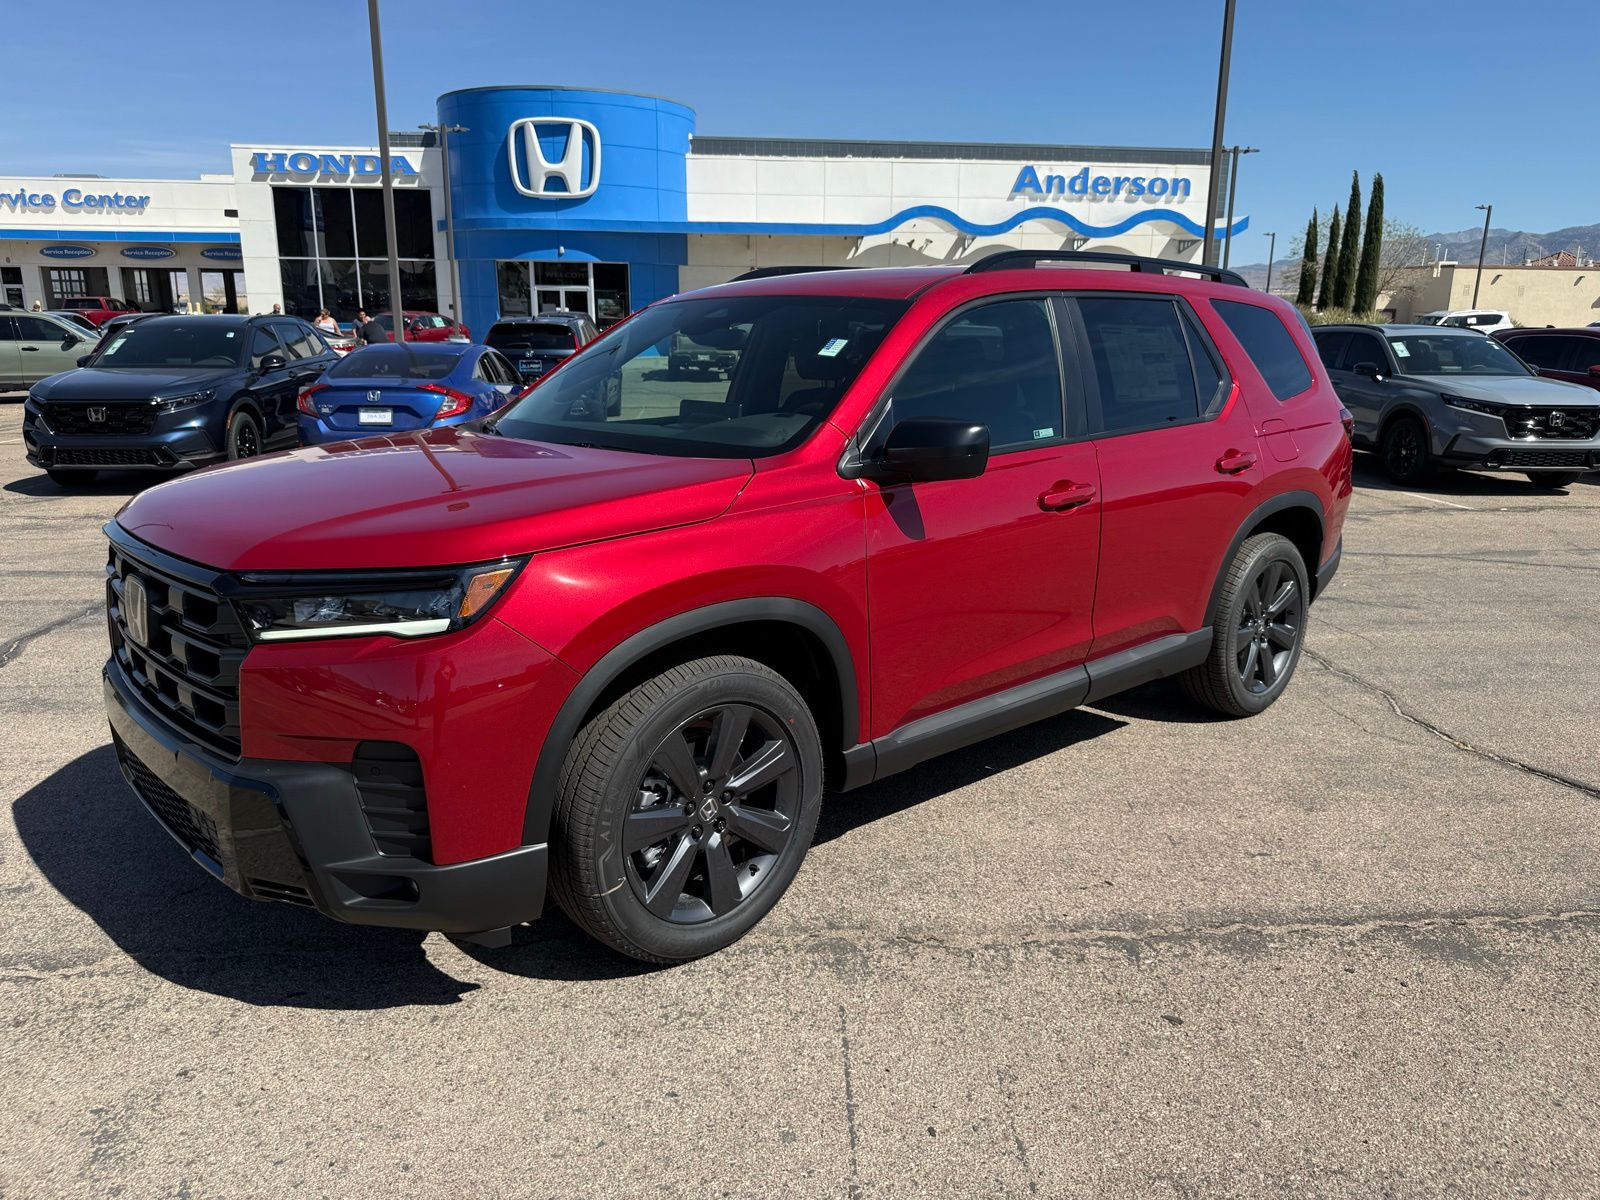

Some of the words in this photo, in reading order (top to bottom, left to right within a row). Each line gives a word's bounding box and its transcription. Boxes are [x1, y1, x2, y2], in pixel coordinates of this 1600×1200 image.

[252, 152, 419, 176] HONDA
[1012, 164, 1191, 197] Anderson
[62, 188, 151, 209] Center
